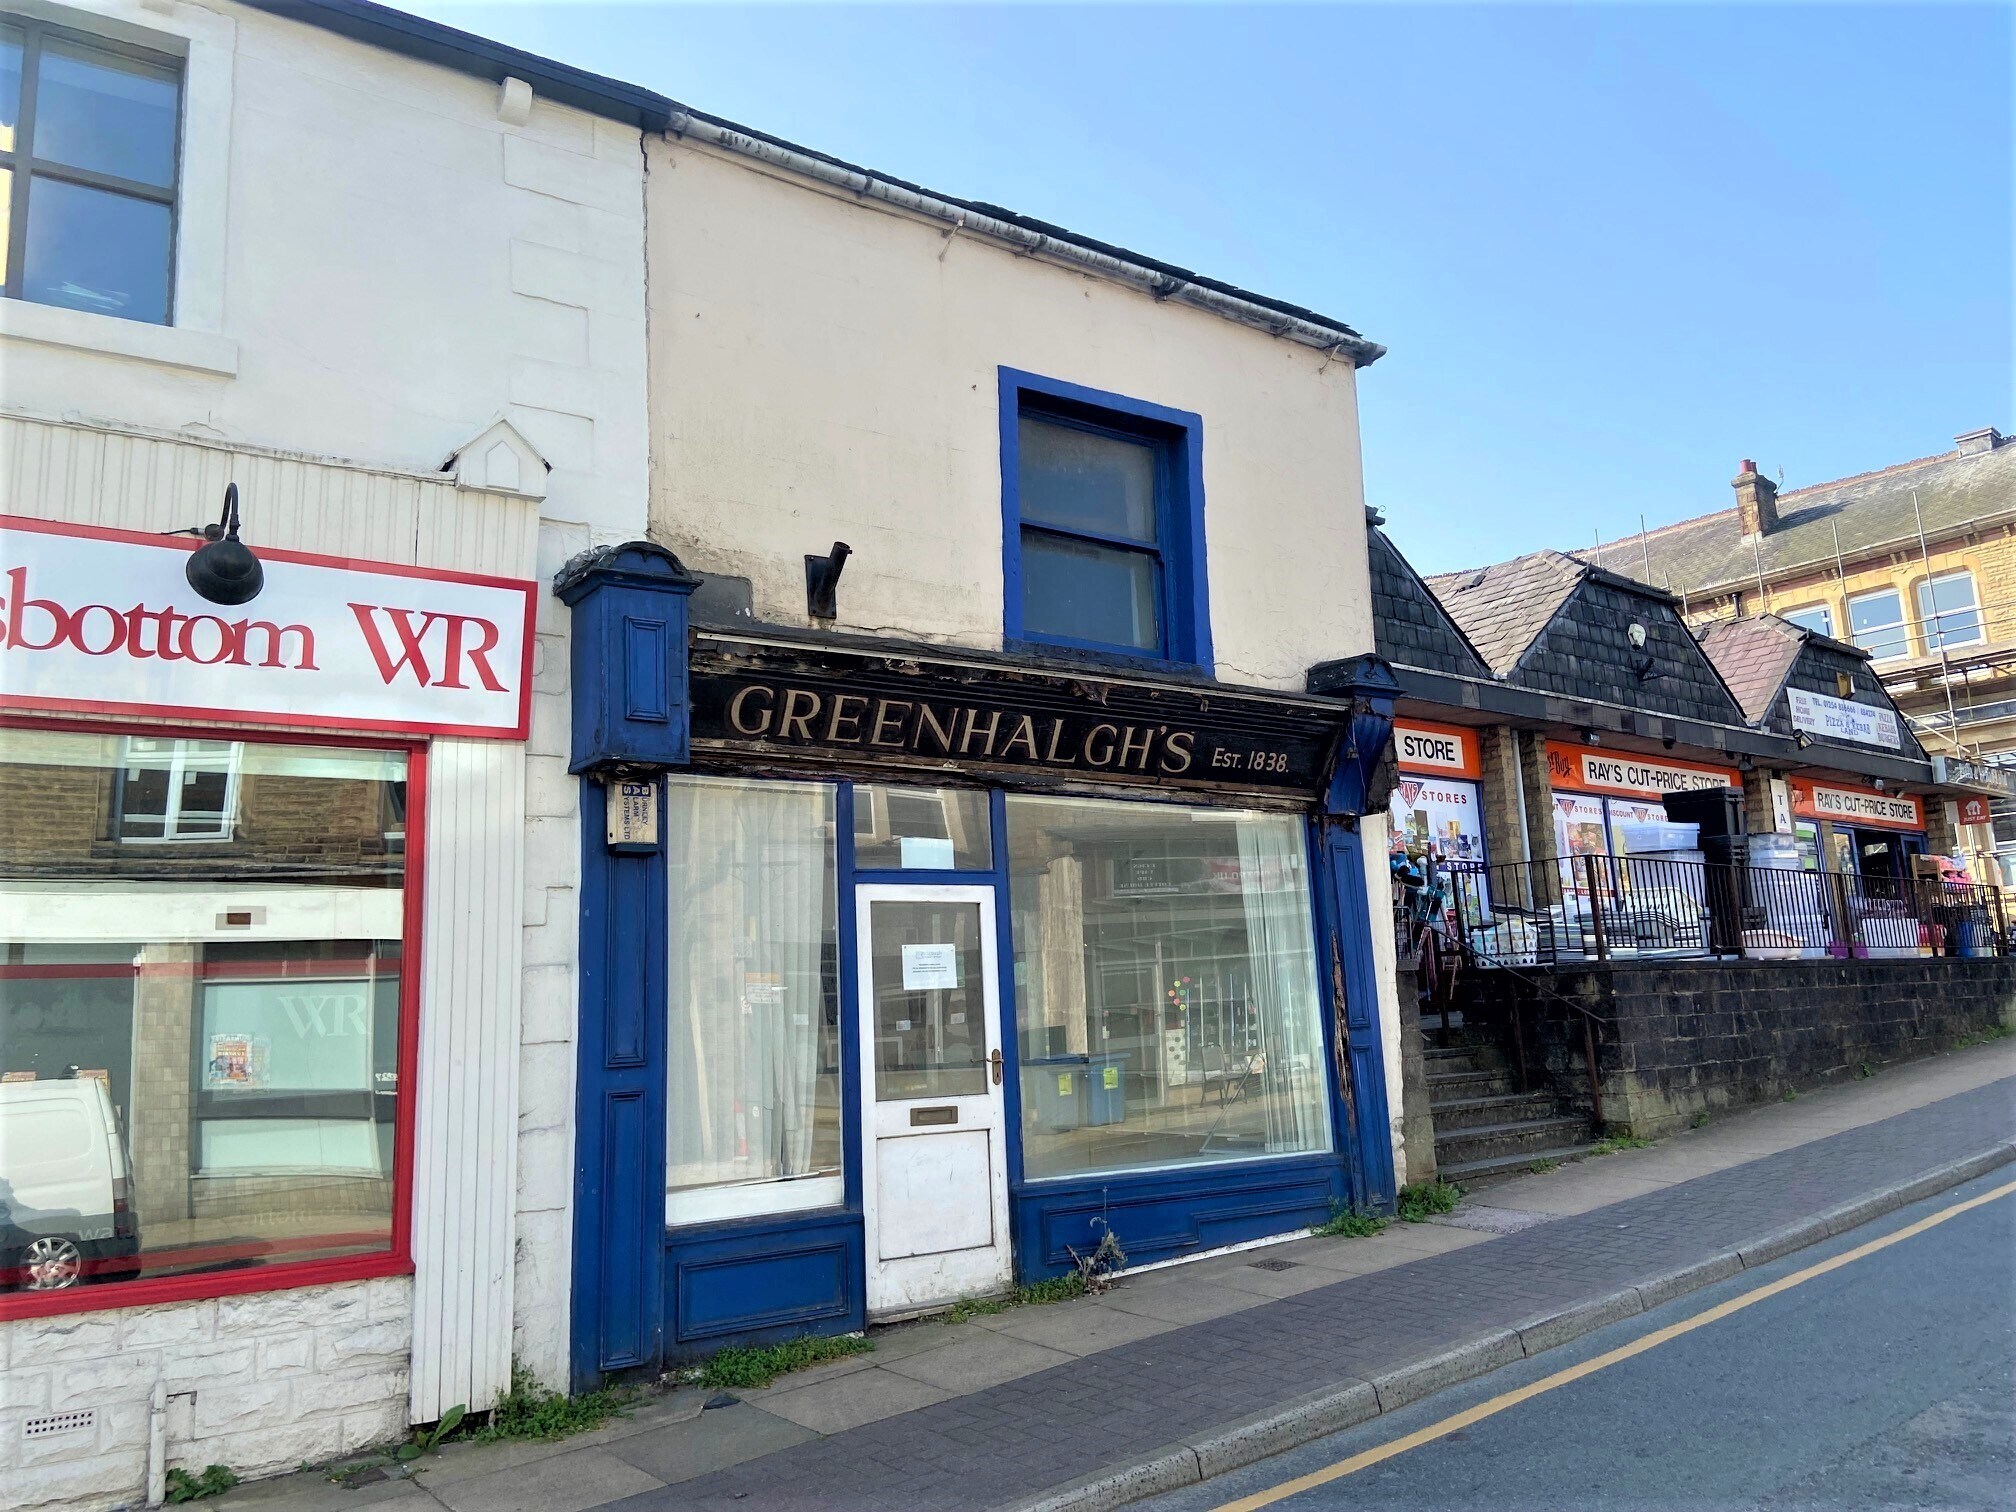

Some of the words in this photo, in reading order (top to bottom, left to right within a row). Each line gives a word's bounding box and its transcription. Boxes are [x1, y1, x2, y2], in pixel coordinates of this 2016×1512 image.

[0, 567, 320, 671] bottom
[347, 602, 510, 692] WR
[730, 685, 1196, 774] GREENHALGH'S
[1404, 736, 1456, 761] STORE
[1588, 761, 1623, 783] RAY'S
[1627, 767, 1688, 791] CUT-PRICE
[1422, 790, 1467, 804] STORES
[1818, 792, 1842, 811] RAY'S
[1844, 795, 1887, 816] CUT-PRICE
[1889, 802, 1914, 820] STORE
[277, 994, 367, 1039] WR
